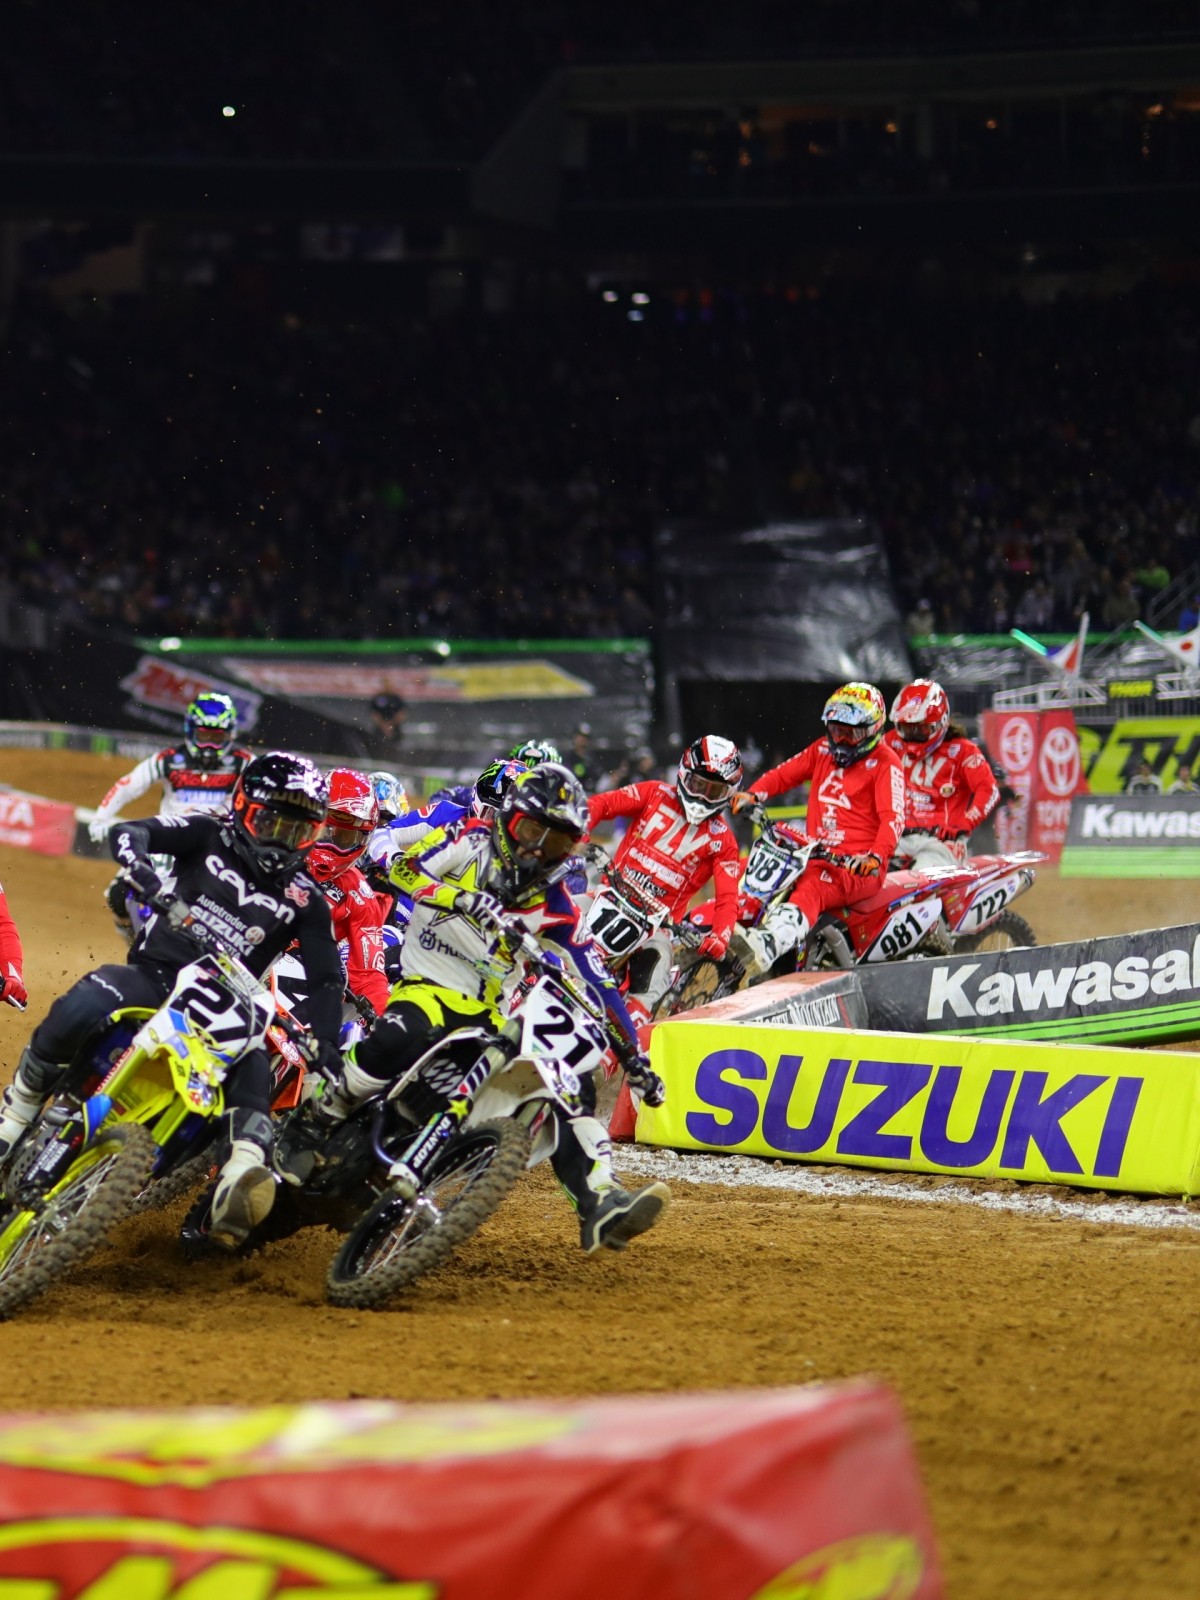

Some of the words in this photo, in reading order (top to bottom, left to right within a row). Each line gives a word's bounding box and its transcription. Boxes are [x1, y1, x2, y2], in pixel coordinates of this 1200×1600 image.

[642, 803, 711, 863] FLY
[189, 904, 256, 957] SUZUKI
[196, 894, 249, 932] Autotrader
[590, 907, 643, 954] 10
[971, 889, 1008, 926] 722
[879, 911, 924, 960] 981
[168, 976, 269, 1045] 27
[532, 1005, 595, 1069] 21
[685, 1049, 1144, 1178] SUZUKI
